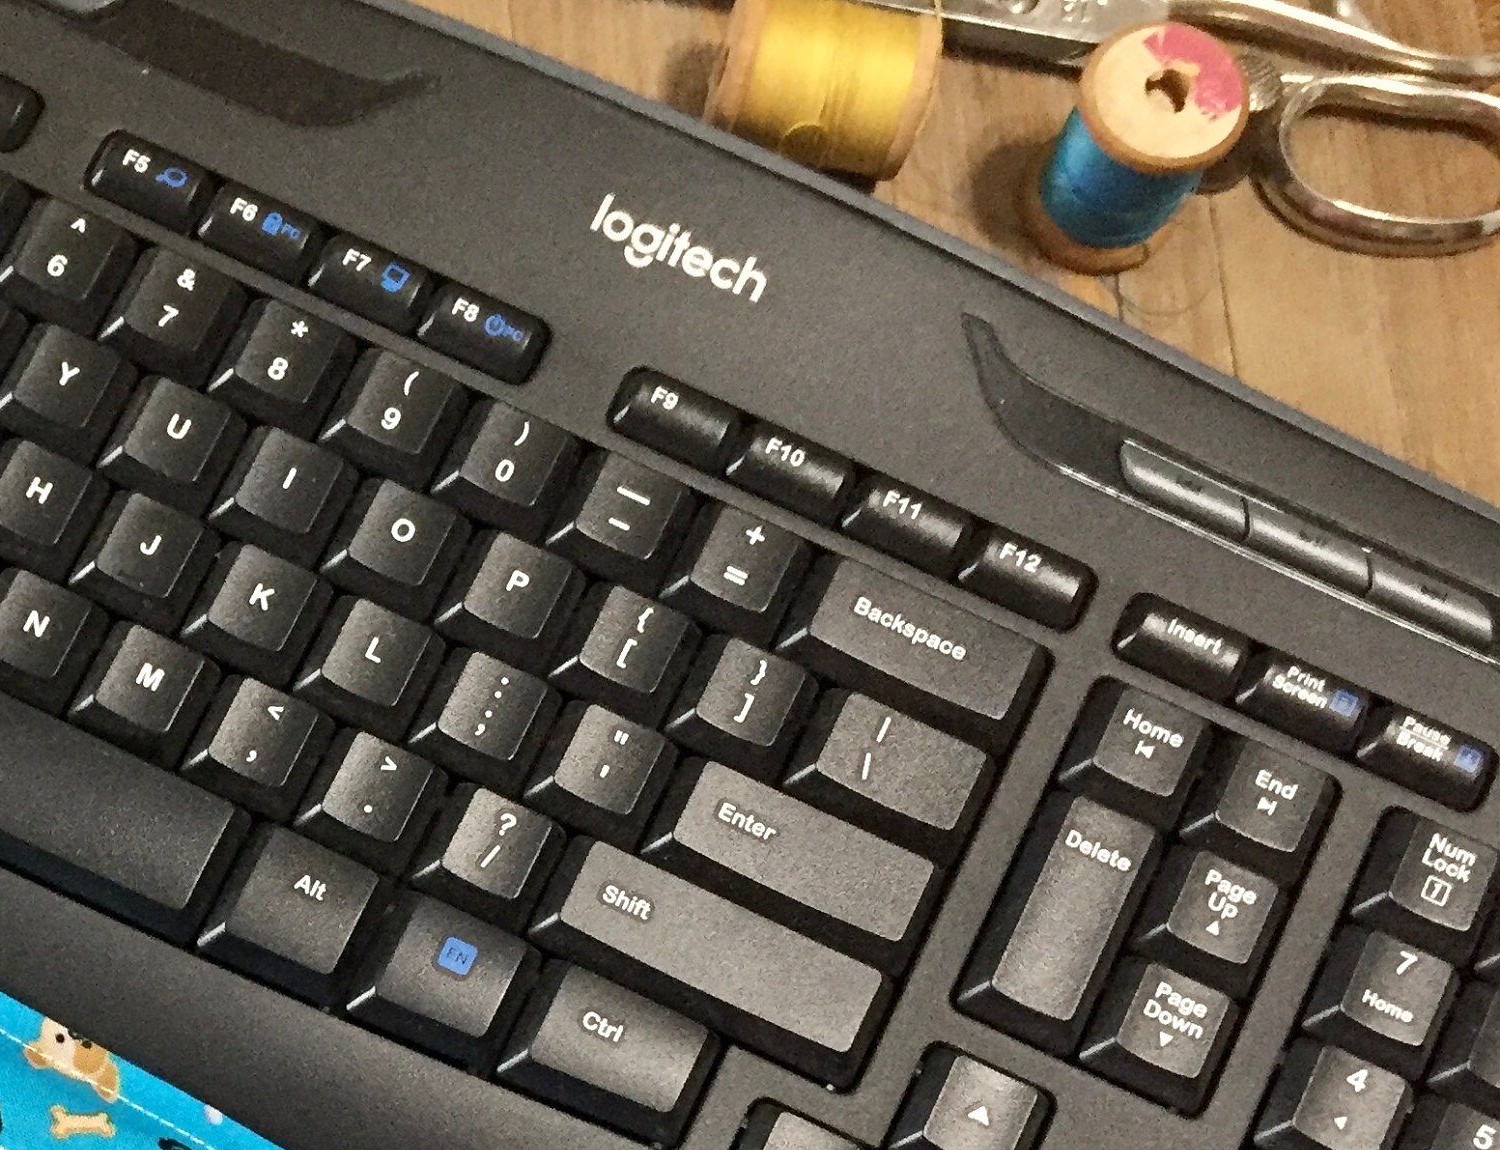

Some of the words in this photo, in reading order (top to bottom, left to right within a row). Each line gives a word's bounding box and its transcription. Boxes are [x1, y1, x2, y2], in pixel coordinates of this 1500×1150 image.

[122, 148, 151, 174] F5
[229, 197, 258, 222] F6
[342, 248, 372, 272] F7
[589, 193, 768, 304] logitech
[47, 254, 68, 277] 6
[176, 268, 196, 292] &
[158, 304, 179, 328] 7
[451, 297, 480, 323] F8
[59, 361, 81, 386] Y
[267, 356, 289, 381] 8
[403, 371, 420, 396] (
[650, 385, 679, 411] F9
[166, 413, 192, 440] U
[380, 406, 402, 430] 9
[514, 421, 530, 446] )
[764, 437, 806, 468] F10
[282, 467, 297, 490] I
[494, 458, 515, 482] 0
[25, 476, 54, 505] H
[882, 490, 925, 522] F11
[390, 517, 416, 543] O
[745, 526, 766, 546] +
[139, 534, 162, 556] J
[998, 542, 1044, 576] F12
[505, 569, 530, 592] P
[723, 565, 749, 586] =
[248, 582, 275, 611] K
[22, 609, 51, 638] N
[636, 607, 654, 634] {
[853, 596, 967, 661] Backspace
[364, 636, 381, 664] L
[1166, 619, 1224, 656] Insert
[616, 639, 638, 669] [
[135, 662, 165, 692] M
[750, 659, 768, 686] }
[1287, 666, 1326, 693] Print
[1272, 674, 1328, 709] Screen
[267, 705, 285, 721] <
[733, 692, 755, 723] ]
[1123, 708, 1184, 748] Home
[1403, 715, 1452, 745] Pause
[1397, 731, 1444, 762] Break
[380, 755, 398, 771] >
[1255, 769, 1299, 800] End
[498, 812, 517, 837] ?
[718, 802, 777, 840] Enter
[480, 844, 501, 868] /
[1065, 829, 1132, 872] Delete
[1427, 832, 1478, 867] Num
[1421, 848, 1471, 884] Lock
[293, 874, 327, 901] Alt
[1204, 869, 1259, 907] Page
[602, 884, 651, 920] Shift
[1208, 891, 1239, 921] Up
[1396, 950, 1419, 976] 7
[1154, 981, 1208, 1019] Page
[1361, 989, 1414, 1023] Home
[582, 1011, 624, 1043] Ctrl
[1142, 999, 1204, 1040] Down
[1346, 1068, 1369, 1093] 4
[1472, 1124, 1497, 1150] 5
